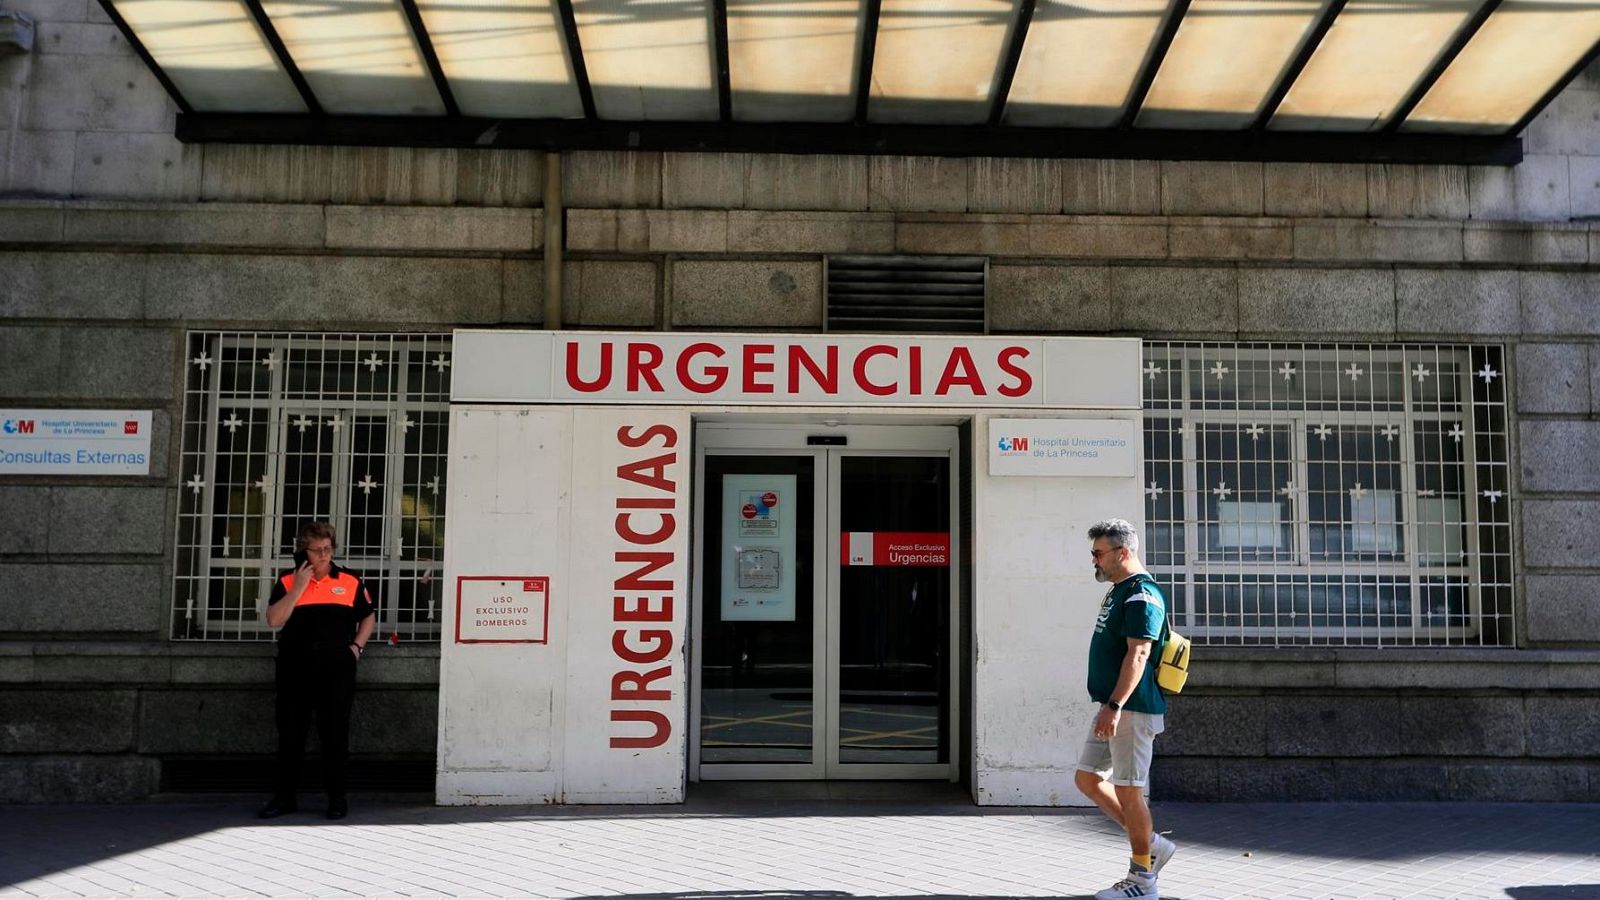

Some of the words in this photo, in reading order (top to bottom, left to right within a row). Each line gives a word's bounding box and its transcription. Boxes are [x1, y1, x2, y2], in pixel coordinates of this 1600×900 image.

[566, 342, 1034, 397] URGENCIAS
[1033, 437, 1069, 448] Hospital
[1071, 438, 1127, 447] Universitario
[76, 449, 145, 464] Externas
[1033, 450, 1045, 458] de
[1047, 450, 1058, 458] La
[1060, 450, 1098, 458] Princesa
[888, 543, 913, 551] Acceso
[914, 543, 946, 551] Exclusivo
[889, 552, 946, 565] Urgencias
[610, 424, 677, 749] URGENCIAS
[493, 596, 513, 604] USO
[476, 607, 529, 615] EXCLUSIVO
[476, 619, 528, 627] BOMBEROS
